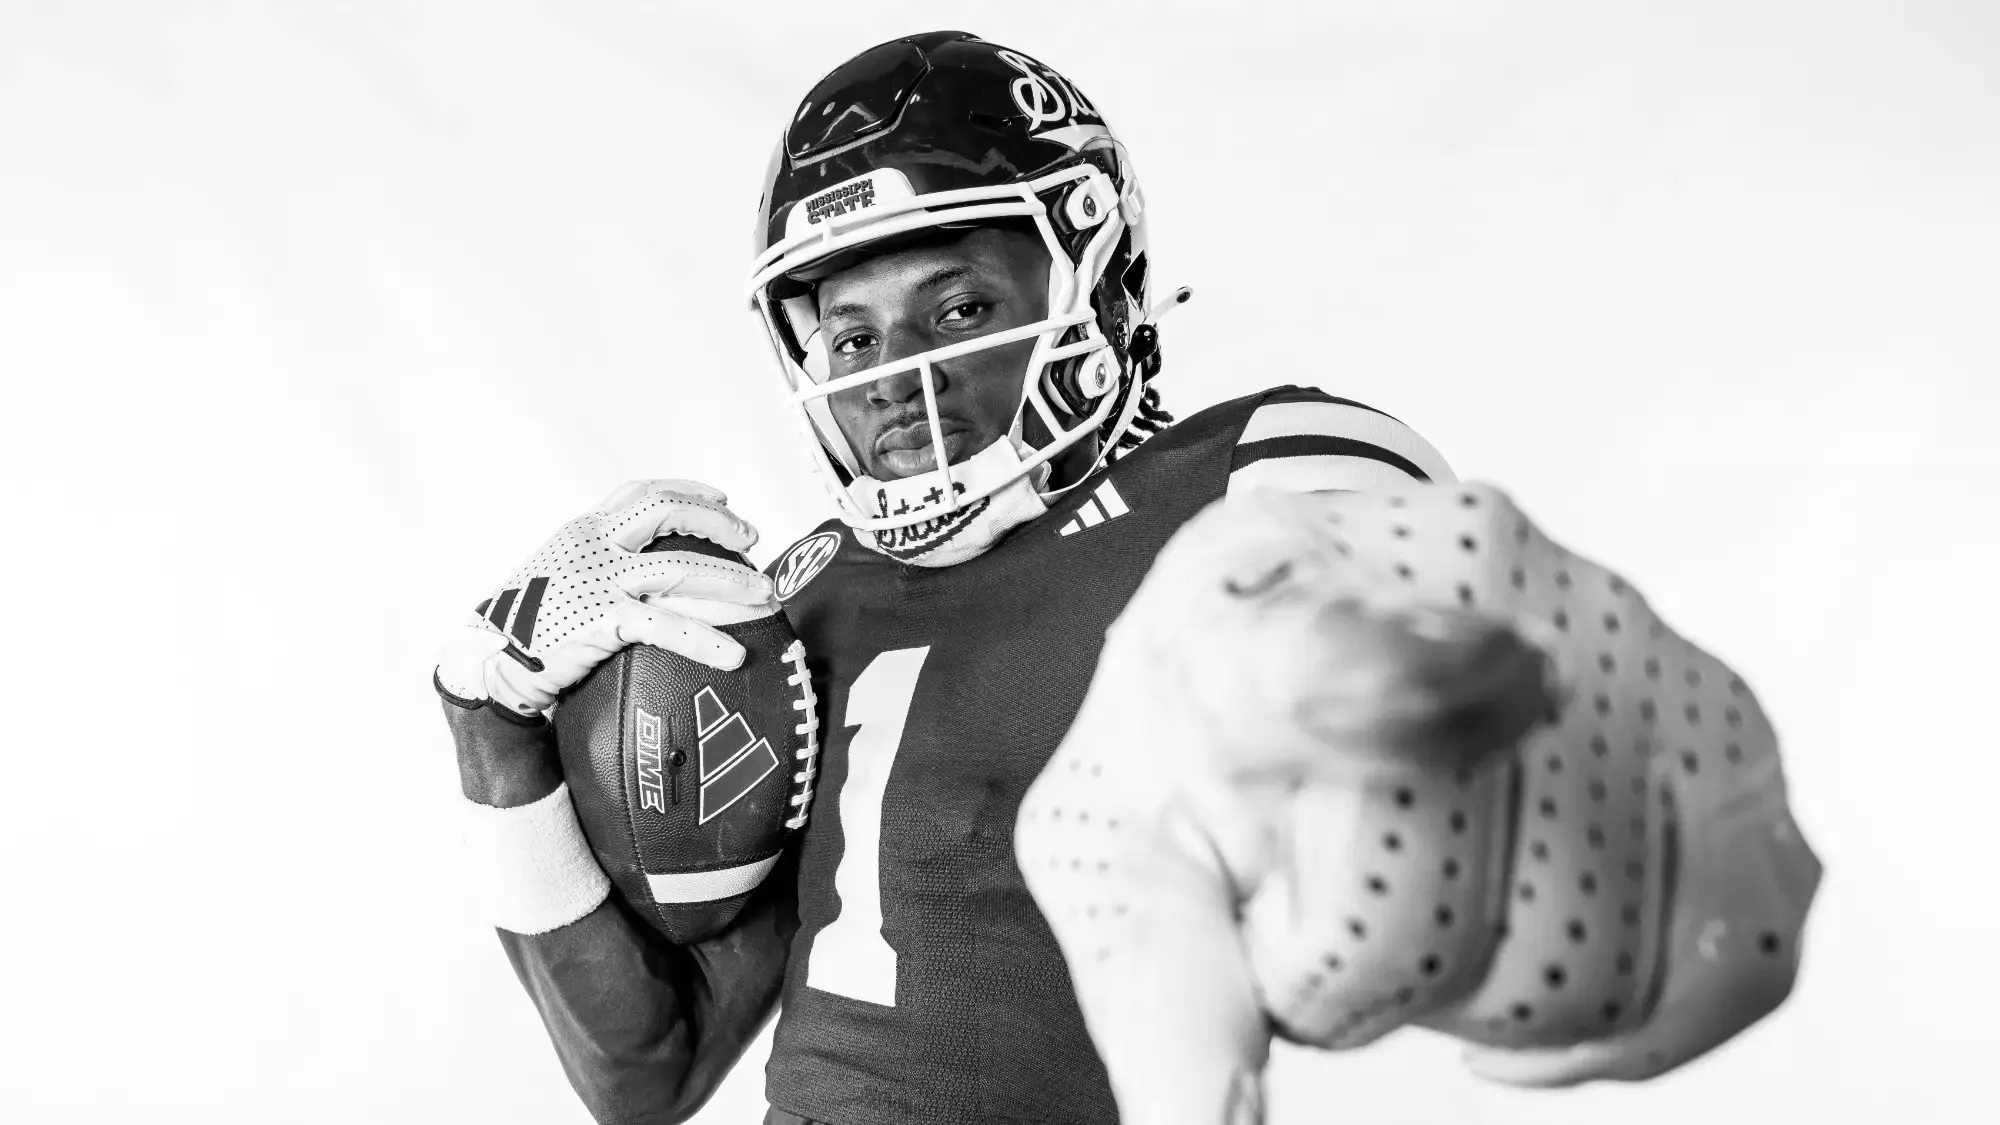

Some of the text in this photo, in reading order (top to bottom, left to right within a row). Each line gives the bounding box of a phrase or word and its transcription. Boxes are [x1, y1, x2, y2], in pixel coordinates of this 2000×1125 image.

[806, 179, 873, 212] MISSISSIPPI
[807, 190, 876, 225] STATE
[778, 535, 836, 595] SEC
[636, 706, 665, 814] DIME
[807, 645, 930, 1007] 1
